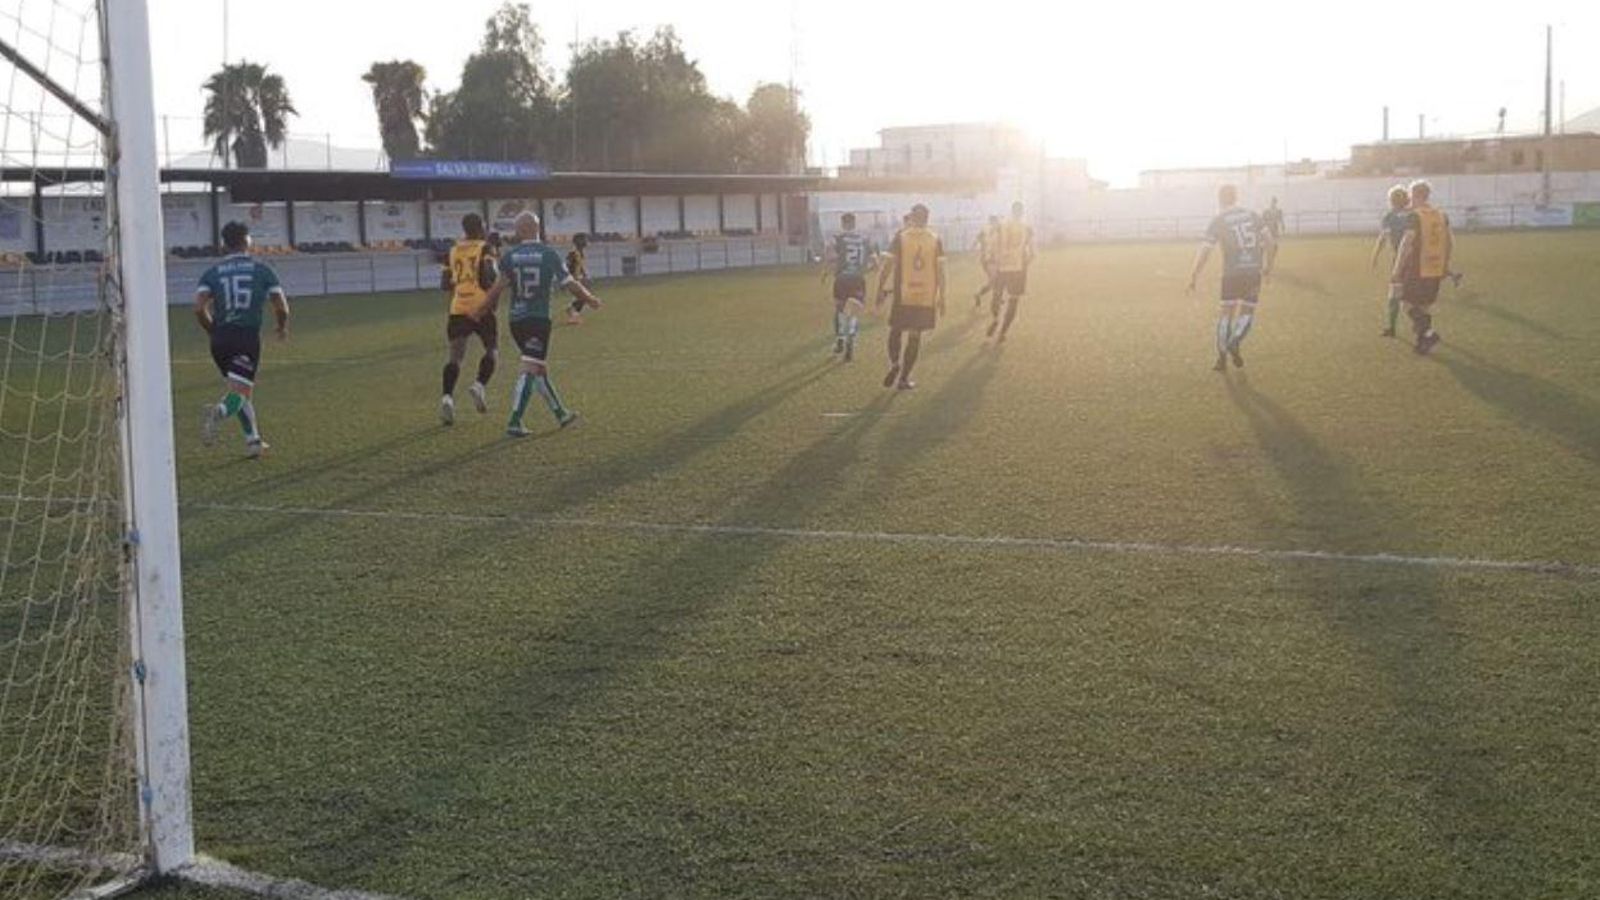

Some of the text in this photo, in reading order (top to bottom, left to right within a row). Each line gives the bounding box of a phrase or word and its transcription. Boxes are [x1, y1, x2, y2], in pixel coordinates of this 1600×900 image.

[1232, 221, 1257, 249] 15
[220, 275, 252, 309] 16
[512, 266, 540, 298] 12
